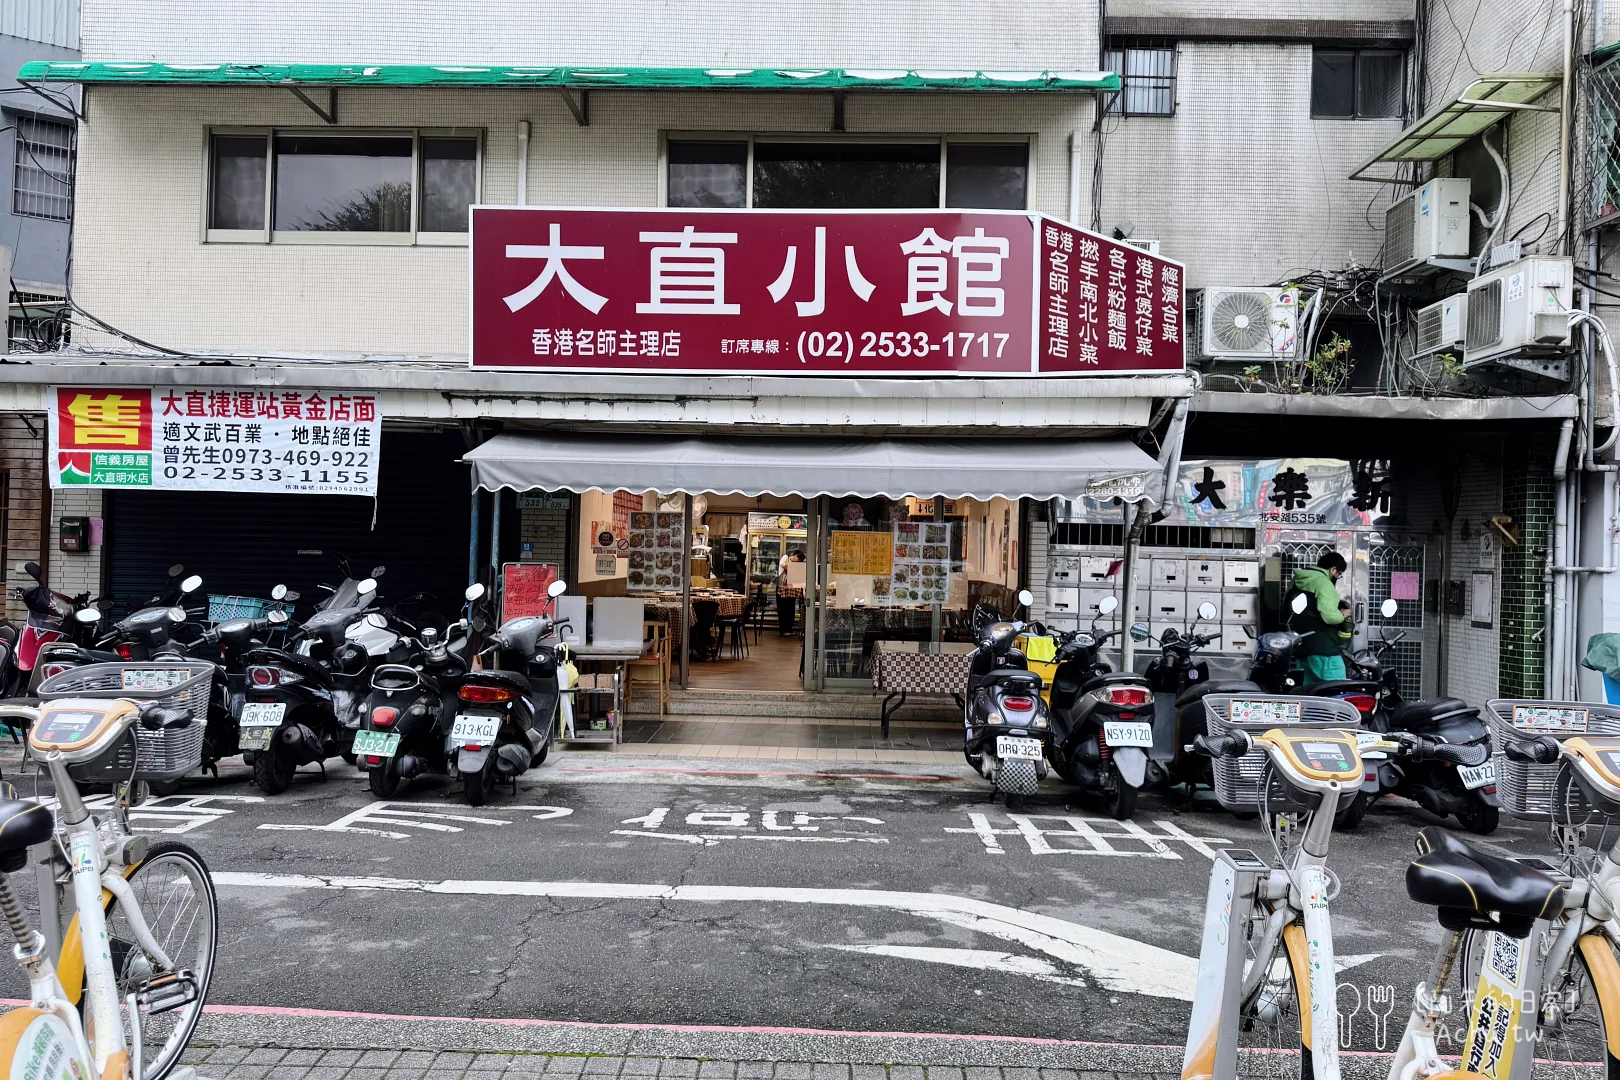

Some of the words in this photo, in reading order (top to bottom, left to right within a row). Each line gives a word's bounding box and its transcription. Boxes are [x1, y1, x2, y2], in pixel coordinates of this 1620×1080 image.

[502, 223, 1011, 317] 大直小館
[1078, 237, 1100, 365] 撚手南北小菜
[1107, 247, 1128, 351] 各式粉麵飯
[1135, 256, 1154, 357] 港式煲仔菜
[1161, 264, 1180, 344] 經濟合菜
[531, 328, 681, 357] 香港名師主理店
[860, 331, 1010, 358] 2533-1717
[160, 388, 376, 423] 大直捷運站黃金店面
[67, 393, 142, 445] 售
[94, 454, 149, 466] 信義房屋
[93, 472, 149, 484] 大直明水店
[163, 466, 369, 484] 02-2533-1155
[1259, 512, 1327, 524] 北安路535號
[242, 711, 283, 723] J9K-608
[453, 723, 495, 737] 913-KGL
[1107, 729, 1151, 741] NSY-9120
[354, 737, 398, 752] SJ3-217
[1461, 765, 1495, 784] NAW-22
